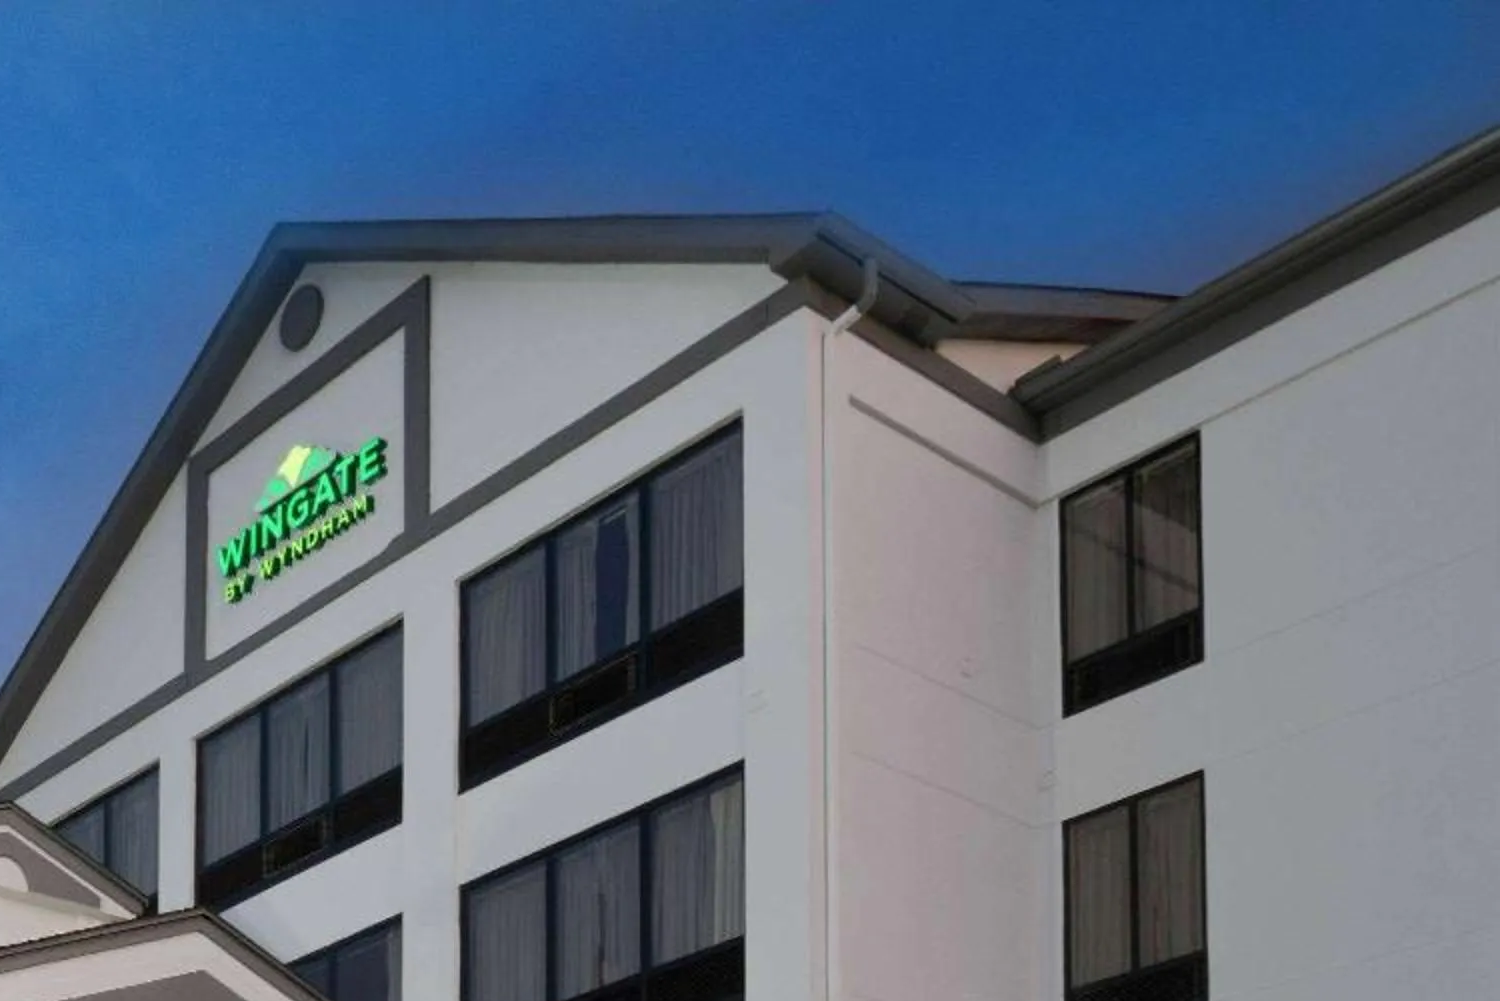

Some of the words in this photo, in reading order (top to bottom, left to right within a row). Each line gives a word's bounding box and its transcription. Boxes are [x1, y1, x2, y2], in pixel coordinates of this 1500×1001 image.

[216, 436, 387, 577] WINGATE
[225, 573, 254, 603] BY
[260, 494, 375, 580] WYNDHAM
